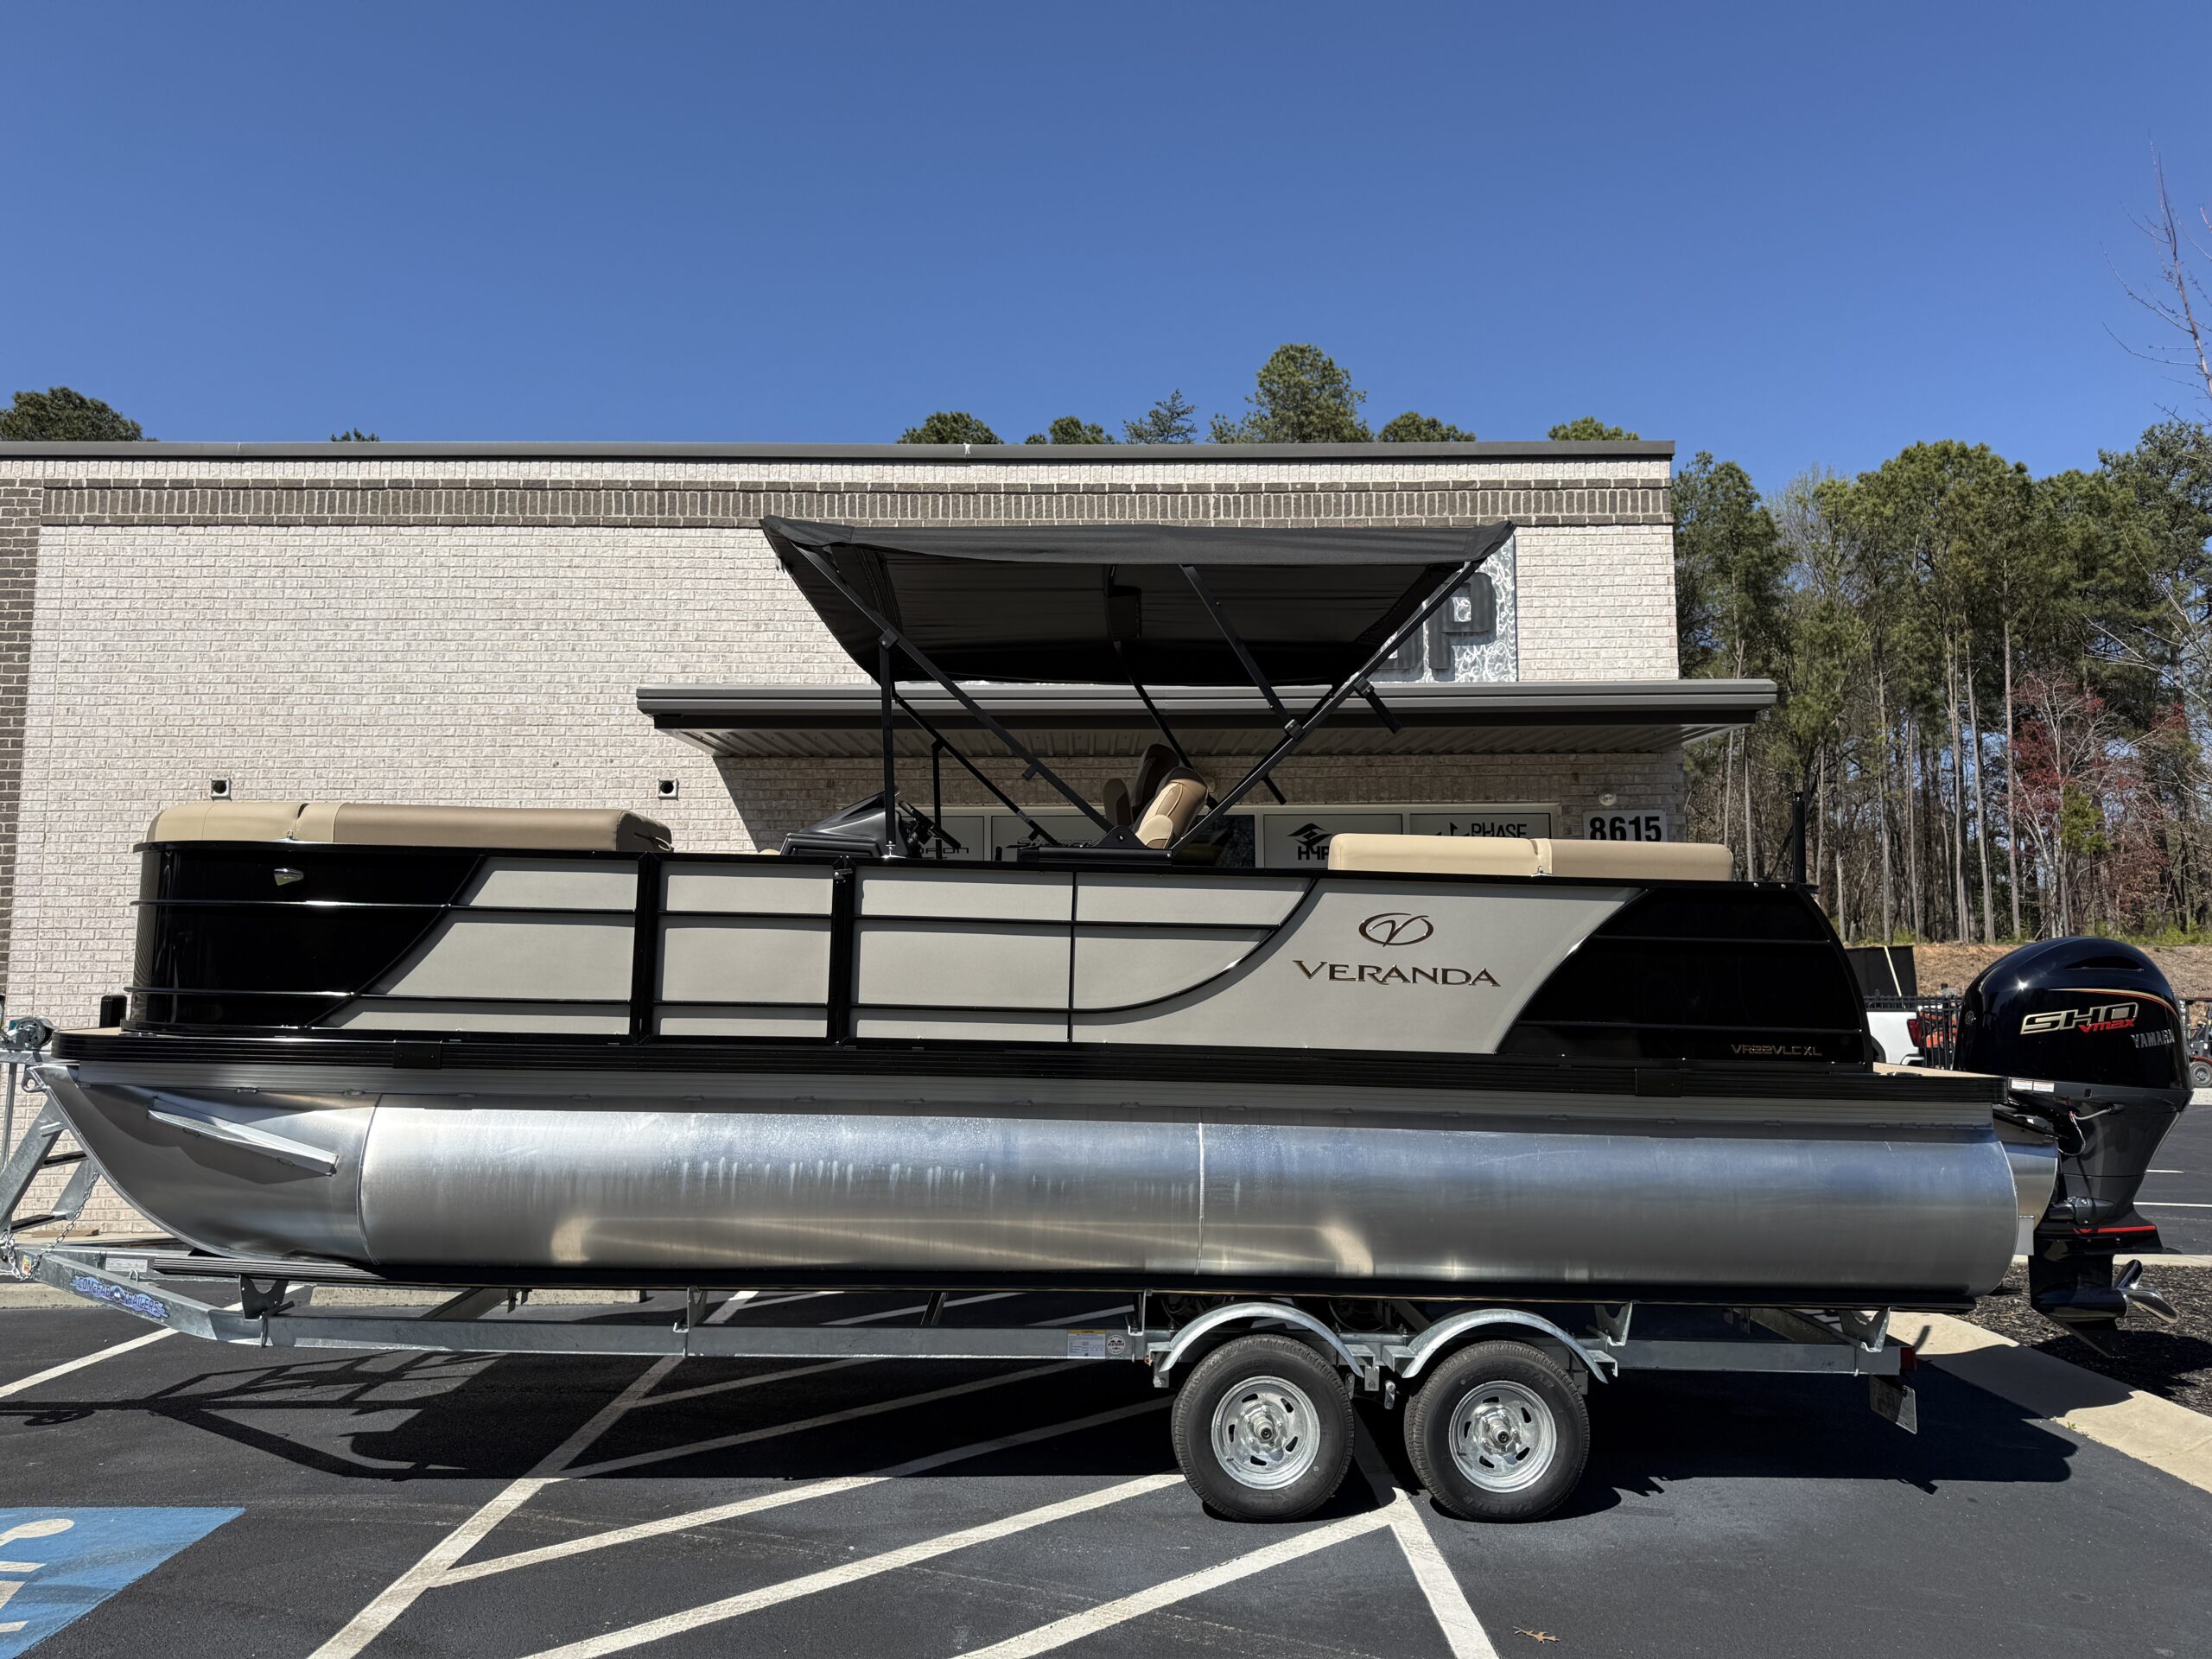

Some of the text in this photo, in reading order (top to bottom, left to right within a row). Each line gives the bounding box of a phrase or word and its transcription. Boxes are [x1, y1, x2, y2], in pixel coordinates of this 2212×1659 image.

[1471, 823, 1528, 838] PHASE
[1590, 816, 1662, 842] 8615
[1293, 959, 1502, 988] VERANDA
[2020, 1001, 2139, 1035] SHO
[123, 1291, 161, 1313] TRAILERS
